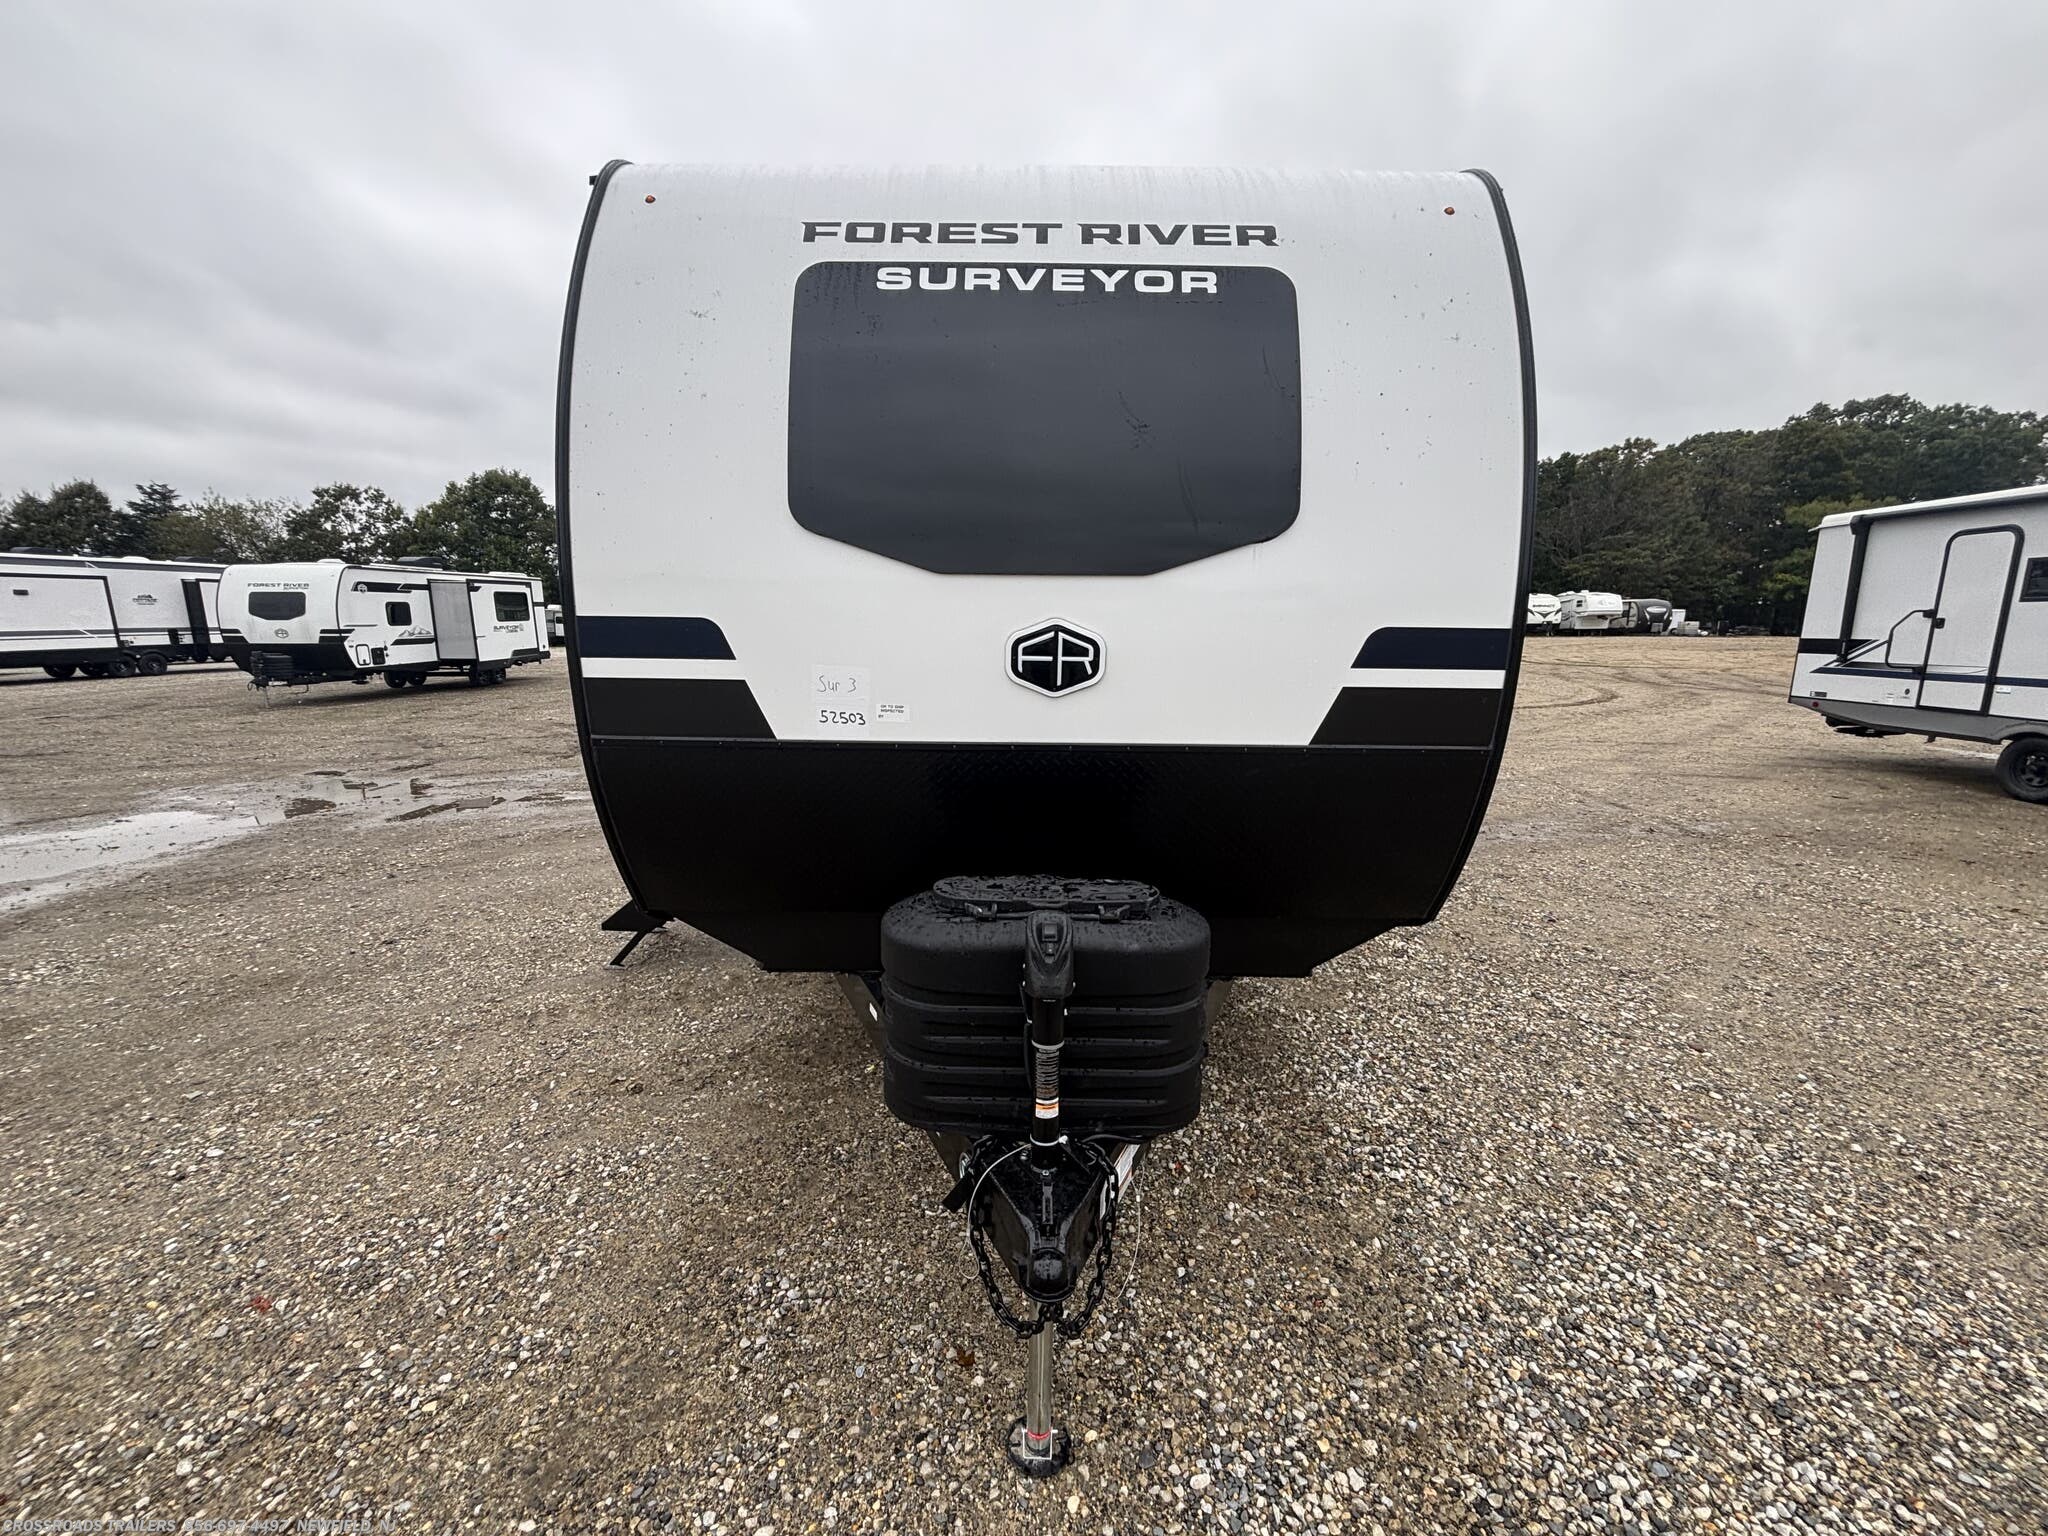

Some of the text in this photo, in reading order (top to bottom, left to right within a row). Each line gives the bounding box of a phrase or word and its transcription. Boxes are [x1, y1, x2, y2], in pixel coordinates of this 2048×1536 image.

[800, 221, 1280, 247] FOREST RIVER
[876, 267, 1217, 294] SURVEYOR
[847, 677, 857, 693] 3
[819, 709, 867, 725] 52503
